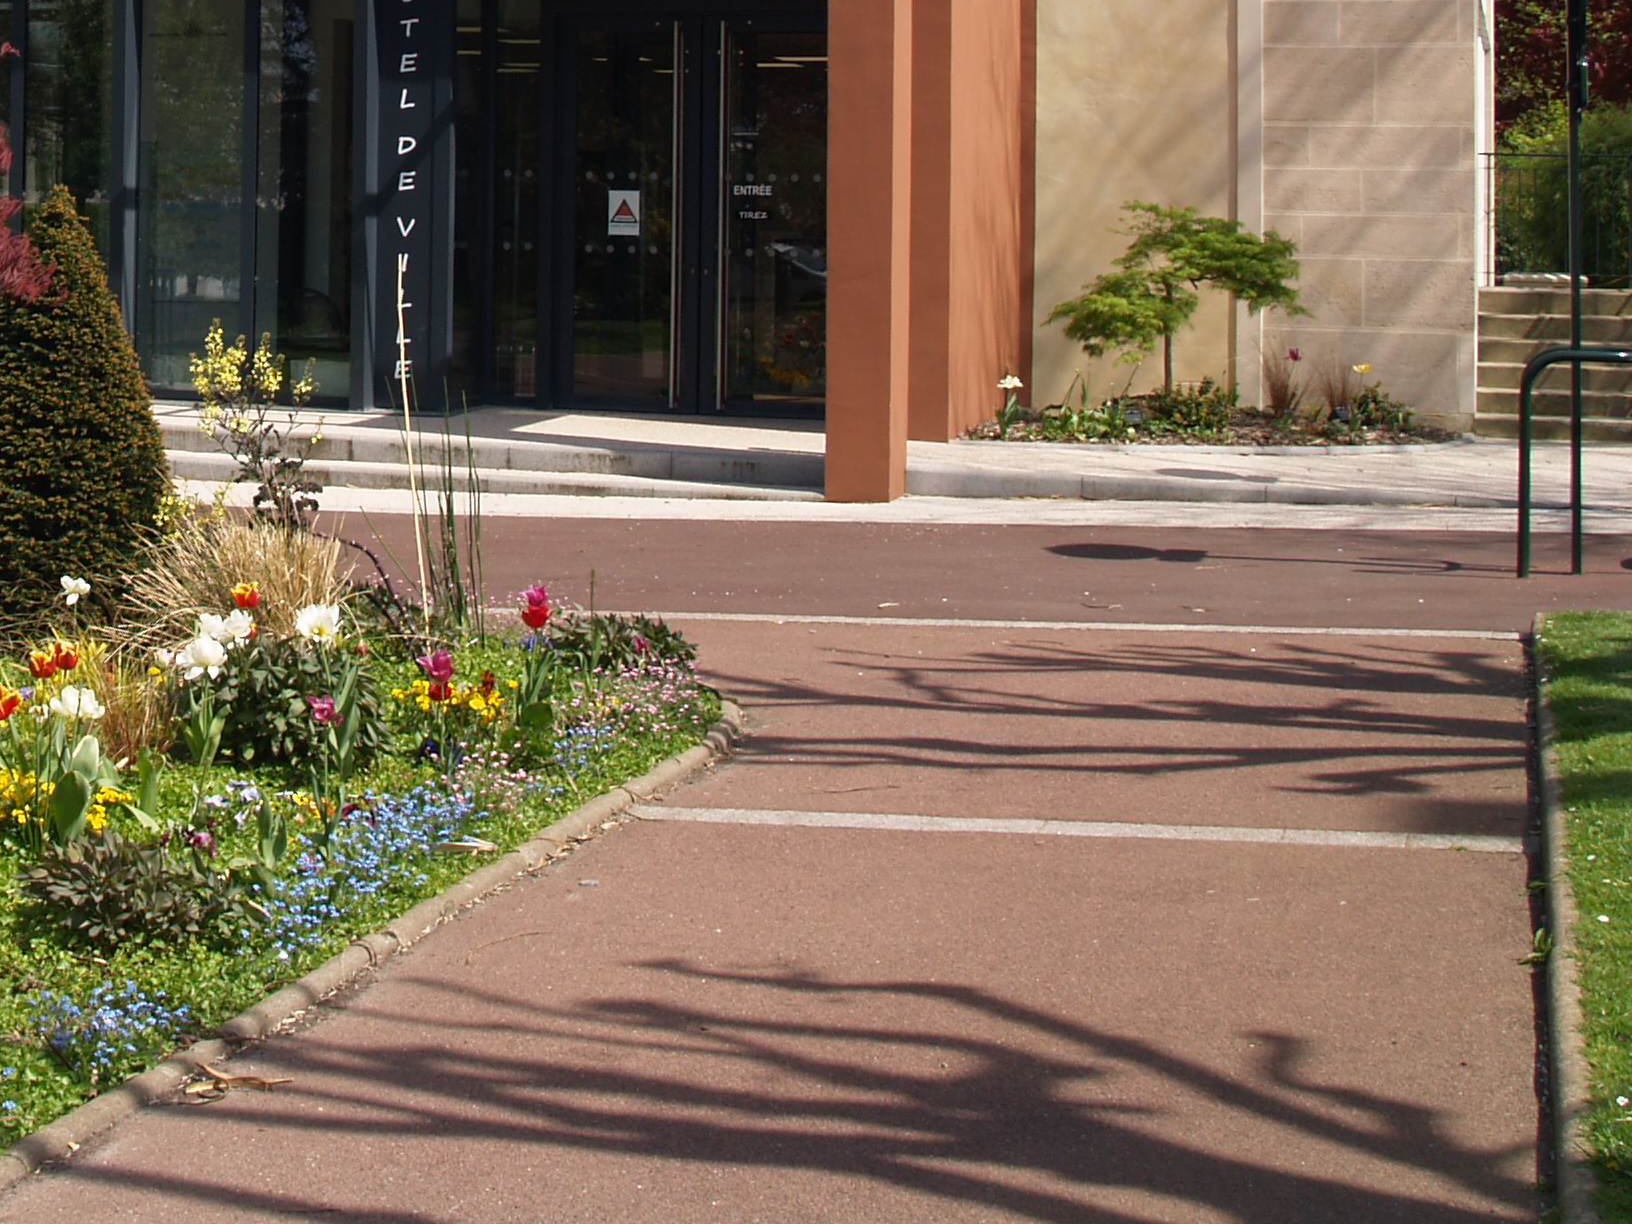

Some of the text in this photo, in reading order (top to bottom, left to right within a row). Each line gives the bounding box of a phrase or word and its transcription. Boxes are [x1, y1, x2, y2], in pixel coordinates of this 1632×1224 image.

[398, 136, 417, 192] DE
[733, 182, 773, 196] ENTRÉE
[739, 210, 768, 220] TIREZ
